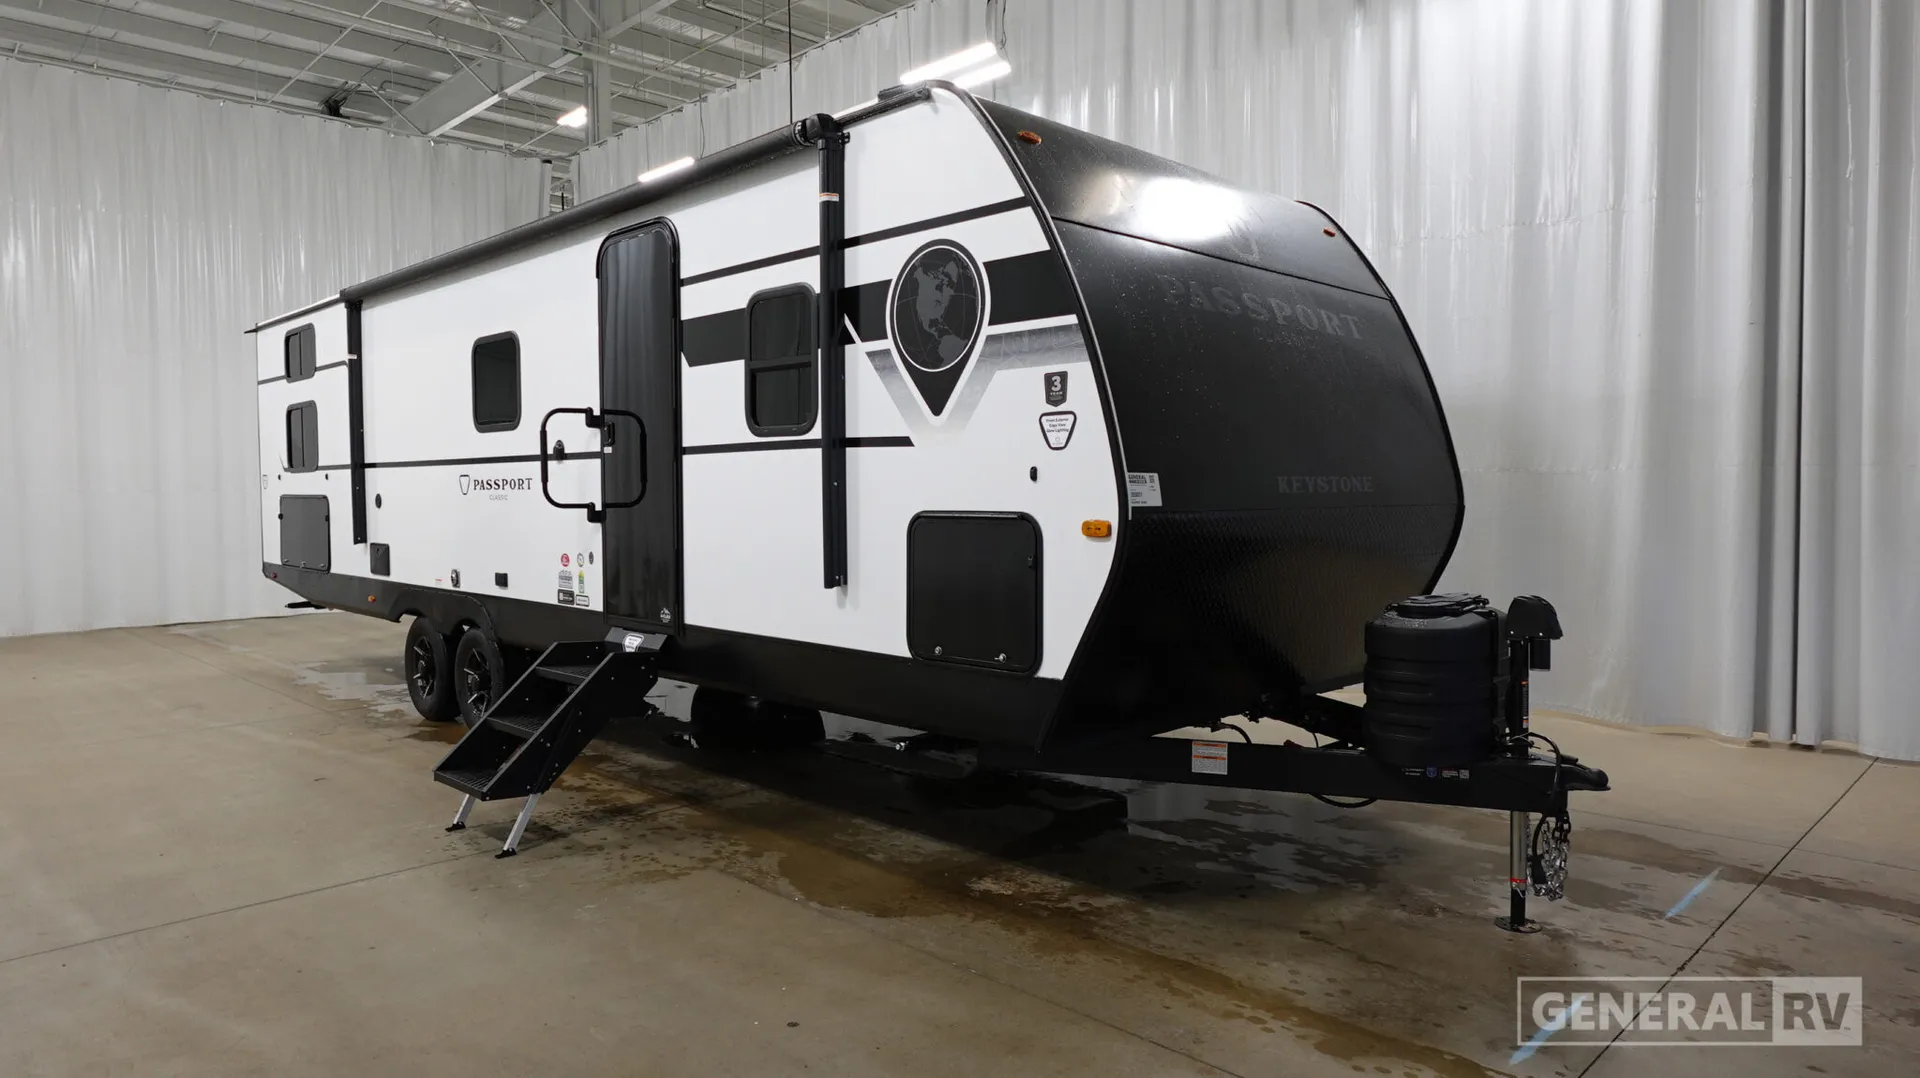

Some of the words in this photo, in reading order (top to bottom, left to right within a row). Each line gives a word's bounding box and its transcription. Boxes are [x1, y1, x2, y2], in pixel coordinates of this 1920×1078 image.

[1157, 274, 1363, 339] PASSPORT
[1051, 375, 1062, 392] 3
[473, 478, 533, 491] PASSPORT
[1276, 475, 1375, 494] KEYSTONE
